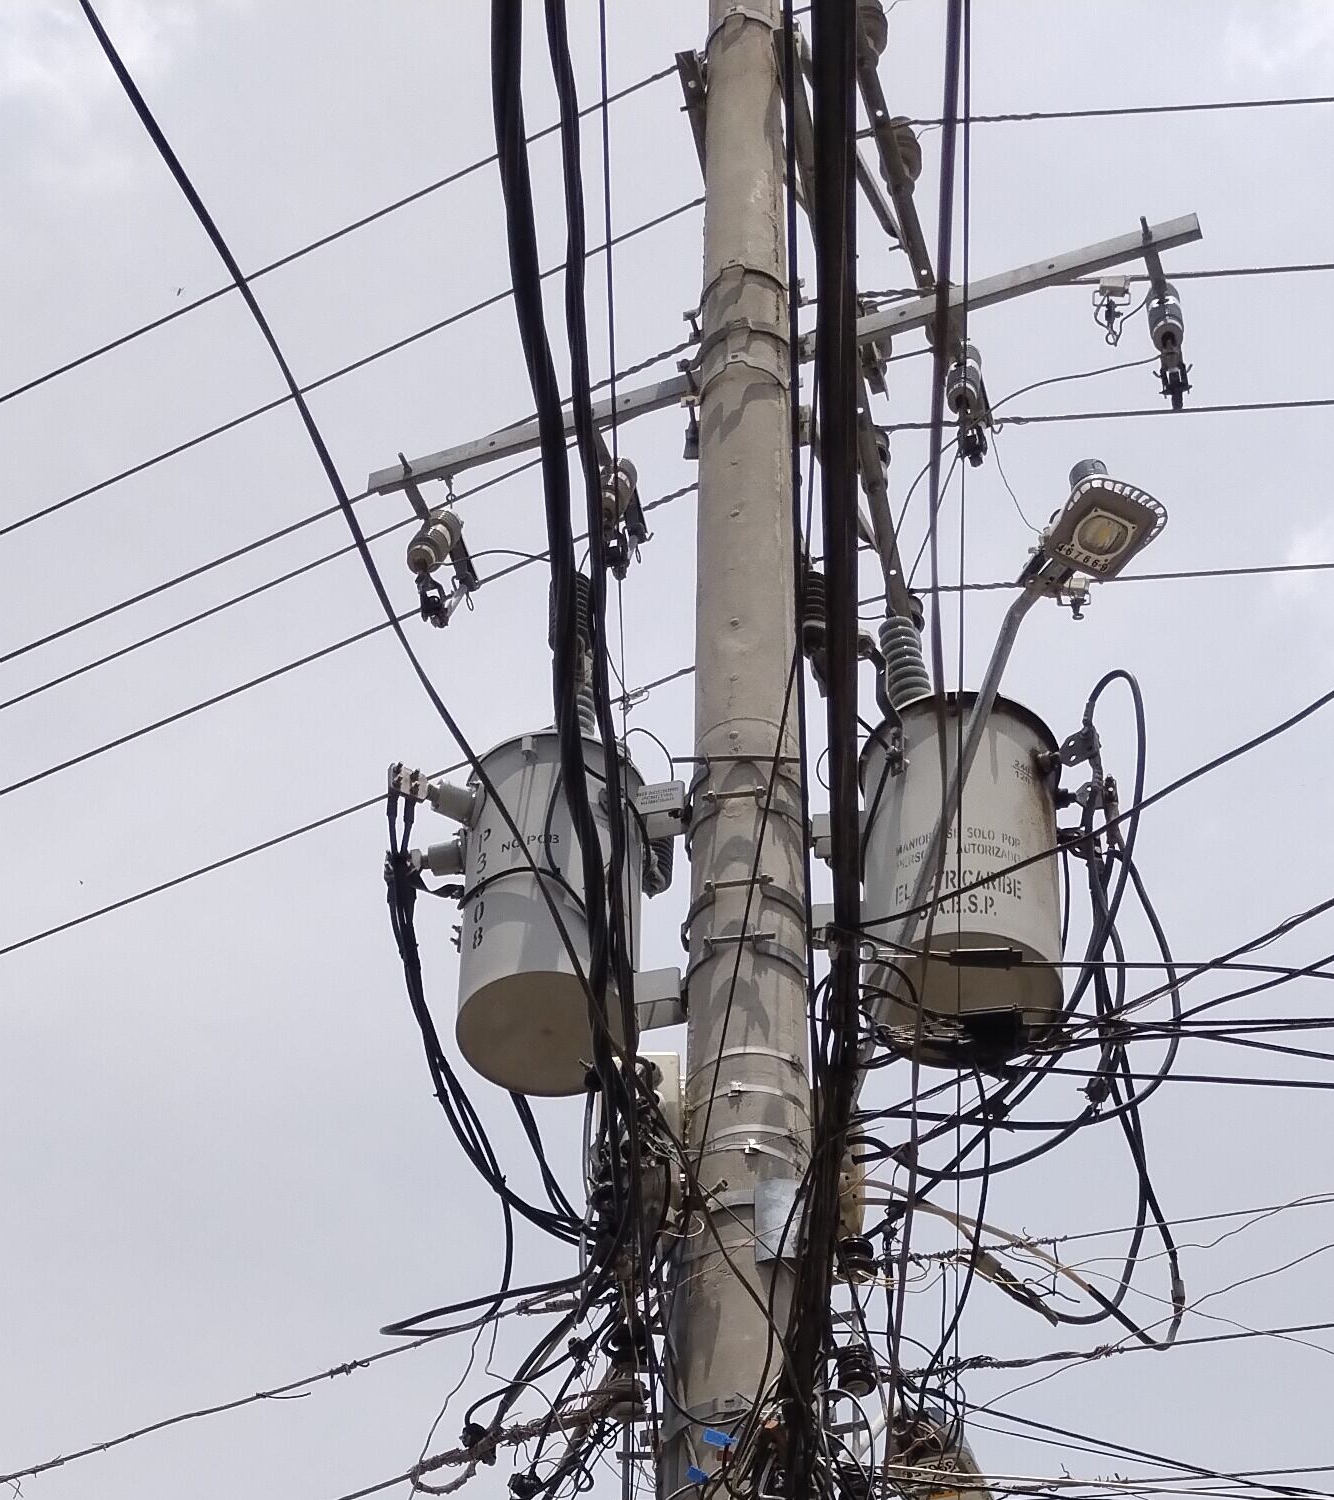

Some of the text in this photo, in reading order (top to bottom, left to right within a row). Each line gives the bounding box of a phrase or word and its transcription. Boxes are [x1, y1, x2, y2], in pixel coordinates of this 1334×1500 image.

[501, 839, 522, 852] NO
[967, 826, 995, 840] SOLO
[1002, 832, 1020, 848] POR
